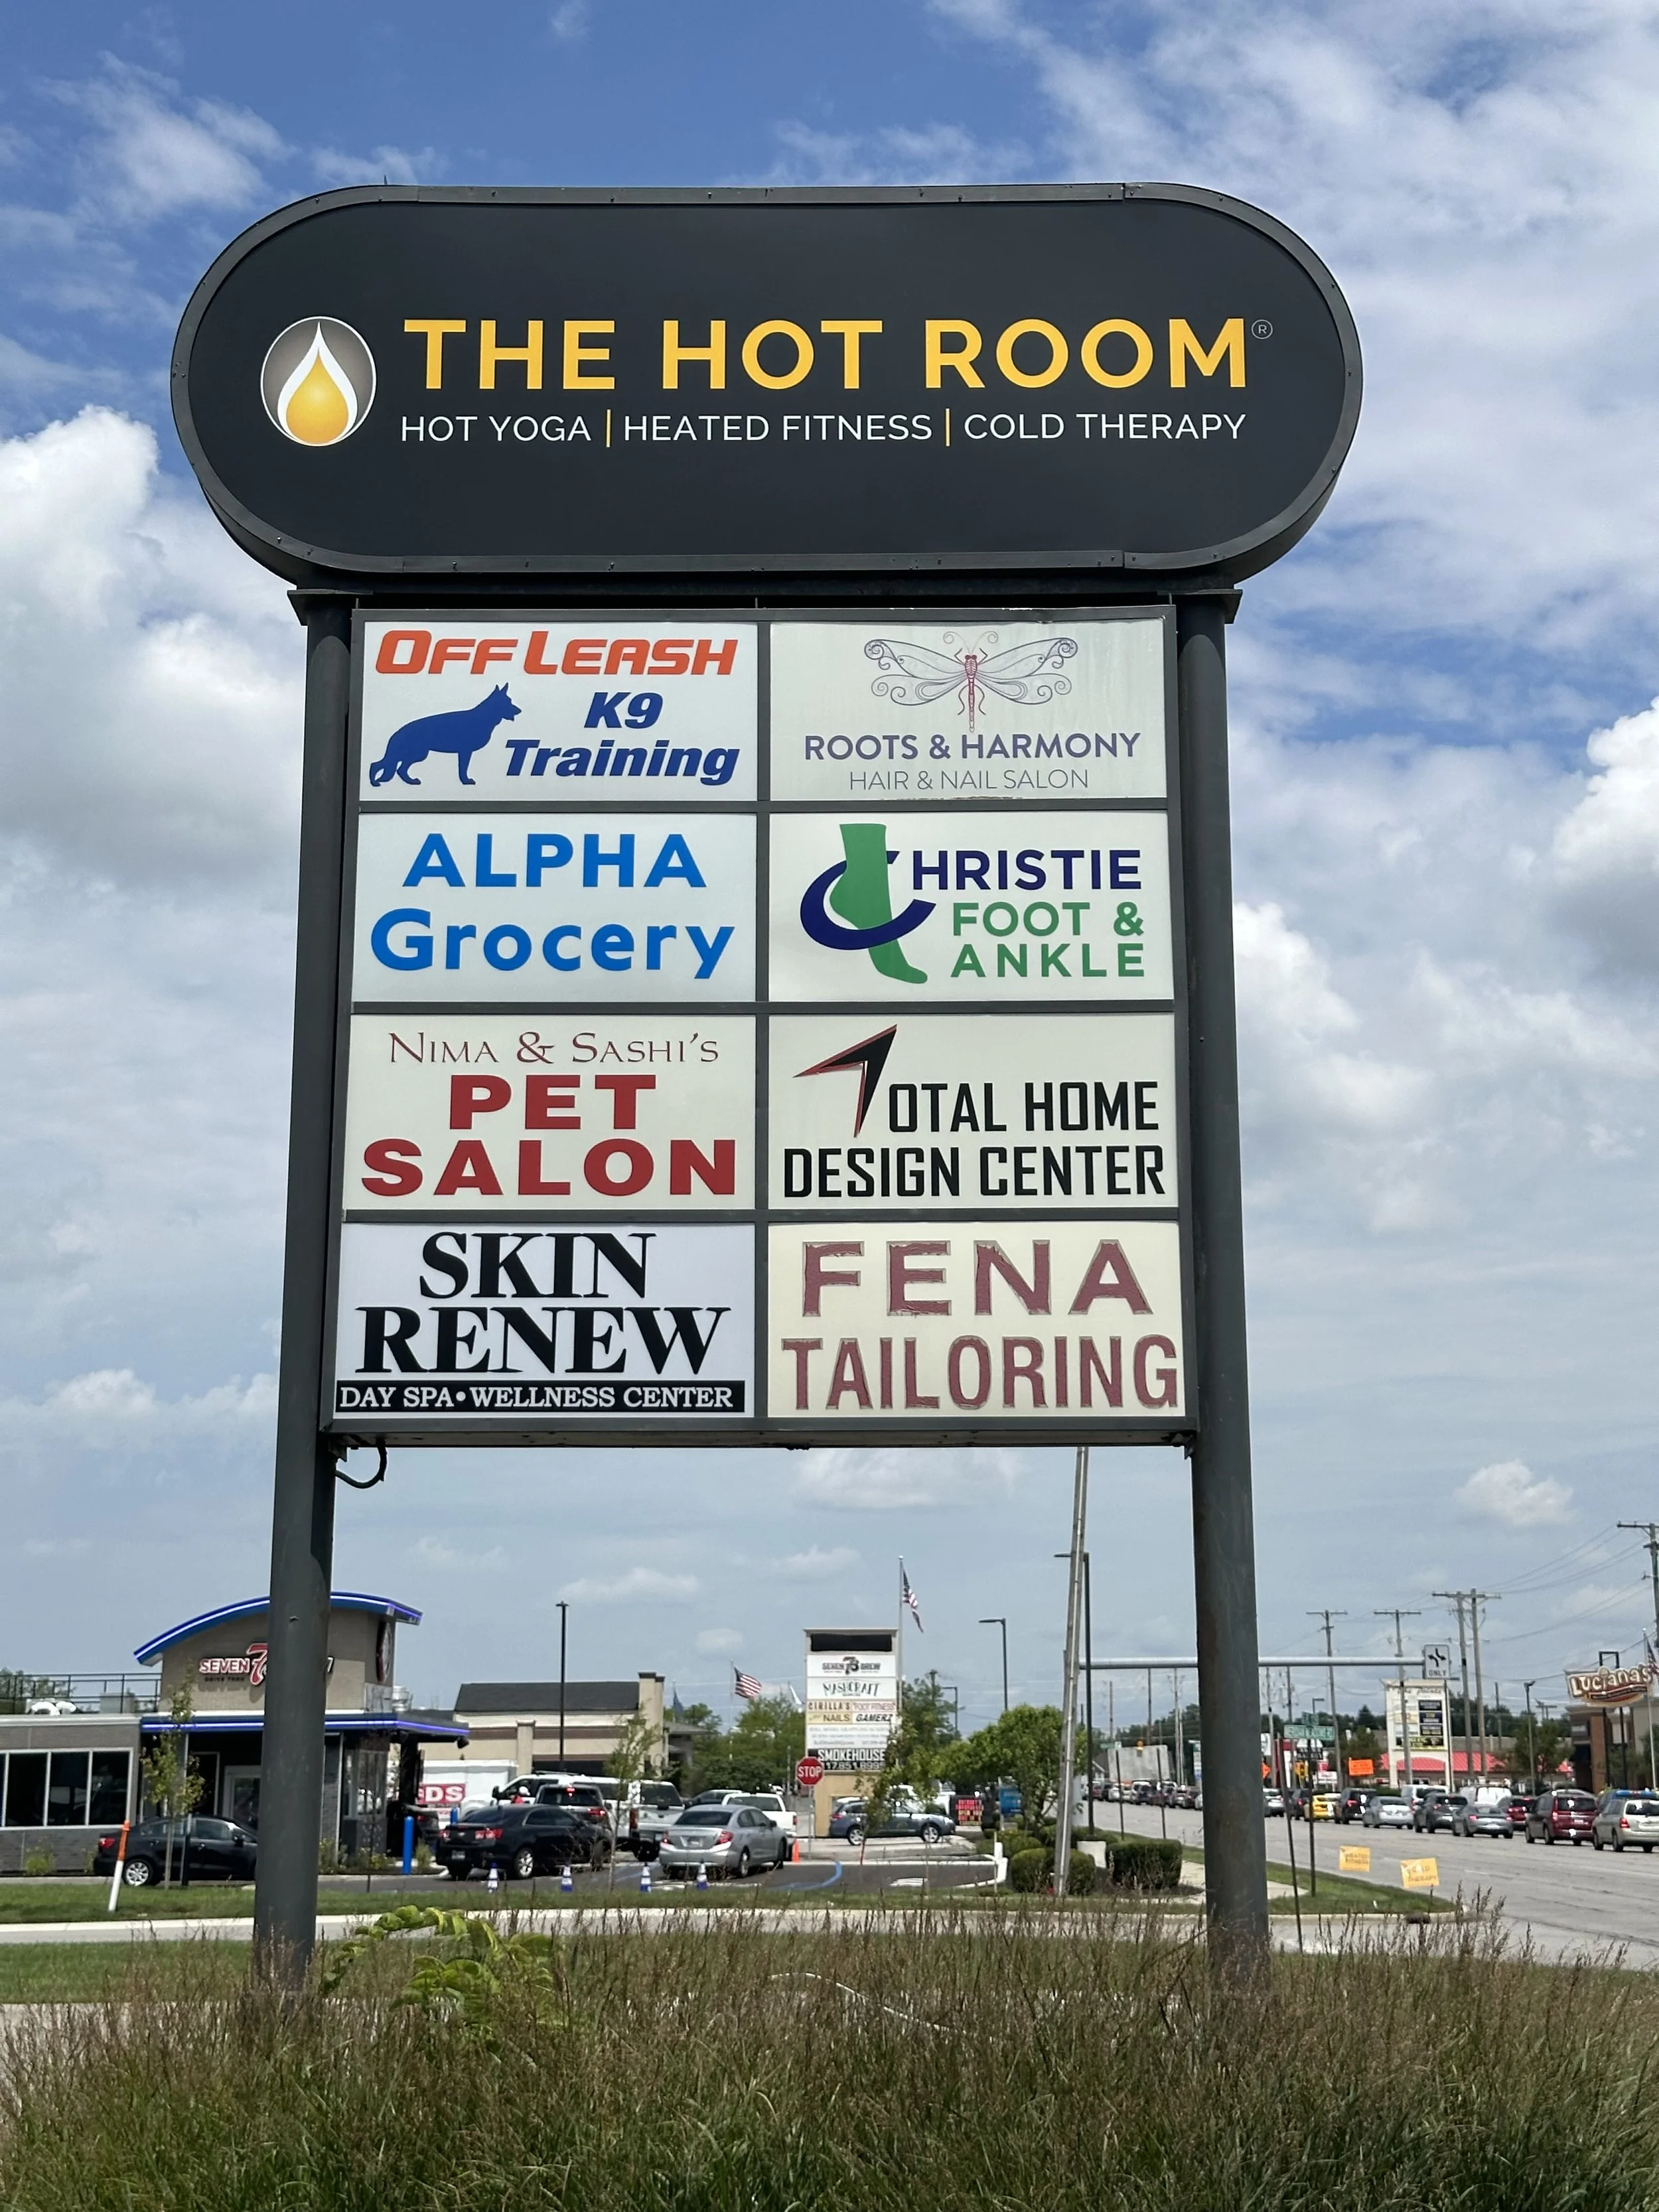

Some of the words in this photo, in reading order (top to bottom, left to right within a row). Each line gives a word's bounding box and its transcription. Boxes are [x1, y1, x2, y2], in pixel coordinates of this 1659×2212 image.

[403, 319, 615, 390] THE
[662, 319, 883, 390] HOT
[401, 415, 478, 441] HOT
[488, 415, 591, 441] YOGA
[624, 415, 768, 441] HEATED
[783, 414, 932, 440] FITNESS
[964, 414, 1064, 439] COLD
[1076, 413, 1246, 439] THERAPY
[375, 630, 518, 675] OFF
[522, 630, 739, 676] LEASH
[584, 692, 664, 729] K9
[505, 739, 740, 786] Training
[804, 734, 919, 761] ROOTS
[928, 734, 951, 760] &
[962, 733, 1141, 759] HARMONY
[849, 771, 909, 790] HAIR
[917, 770, 934, 790] &
[941, 770, 998, 790] NAIL
[1003, 769, 1088, 790] SALON
[401, 833, 707, 887] ALPHA
[953, 901, 1090, 936] FOOT
[1113, 901, 1144, 936] &
[370, 907, 735, 980] Grocery
[950, 943, 1145, 978] ANKLE
[516, 1031, 555, 1064] &
[449, 1074, 657, 1130] PET
[1025, 1081, 1159, 1132] HOME
[360, 1138, 736, 1197] SALON
[784, 1147, 960, 1198] DESIGN
[979, 1145, 1166, 1197] CENTER
[419, 1231, 657, 1299] SKIN
[802, 1239, 1154, 1317] FENA
[354, 1306, 732, 1375] RENEW
[781, 1333, 1179, 1410] TAILORING
[339, 1387, 396, 1408] DAY
[623, 1387, 733, 1408] CENTER
[199, 1657, 250, 1674] SEVEN
[798, 1765, 822, 1777] STOP
[818, 1749, 885, 1761] SMOKEHOUSE
